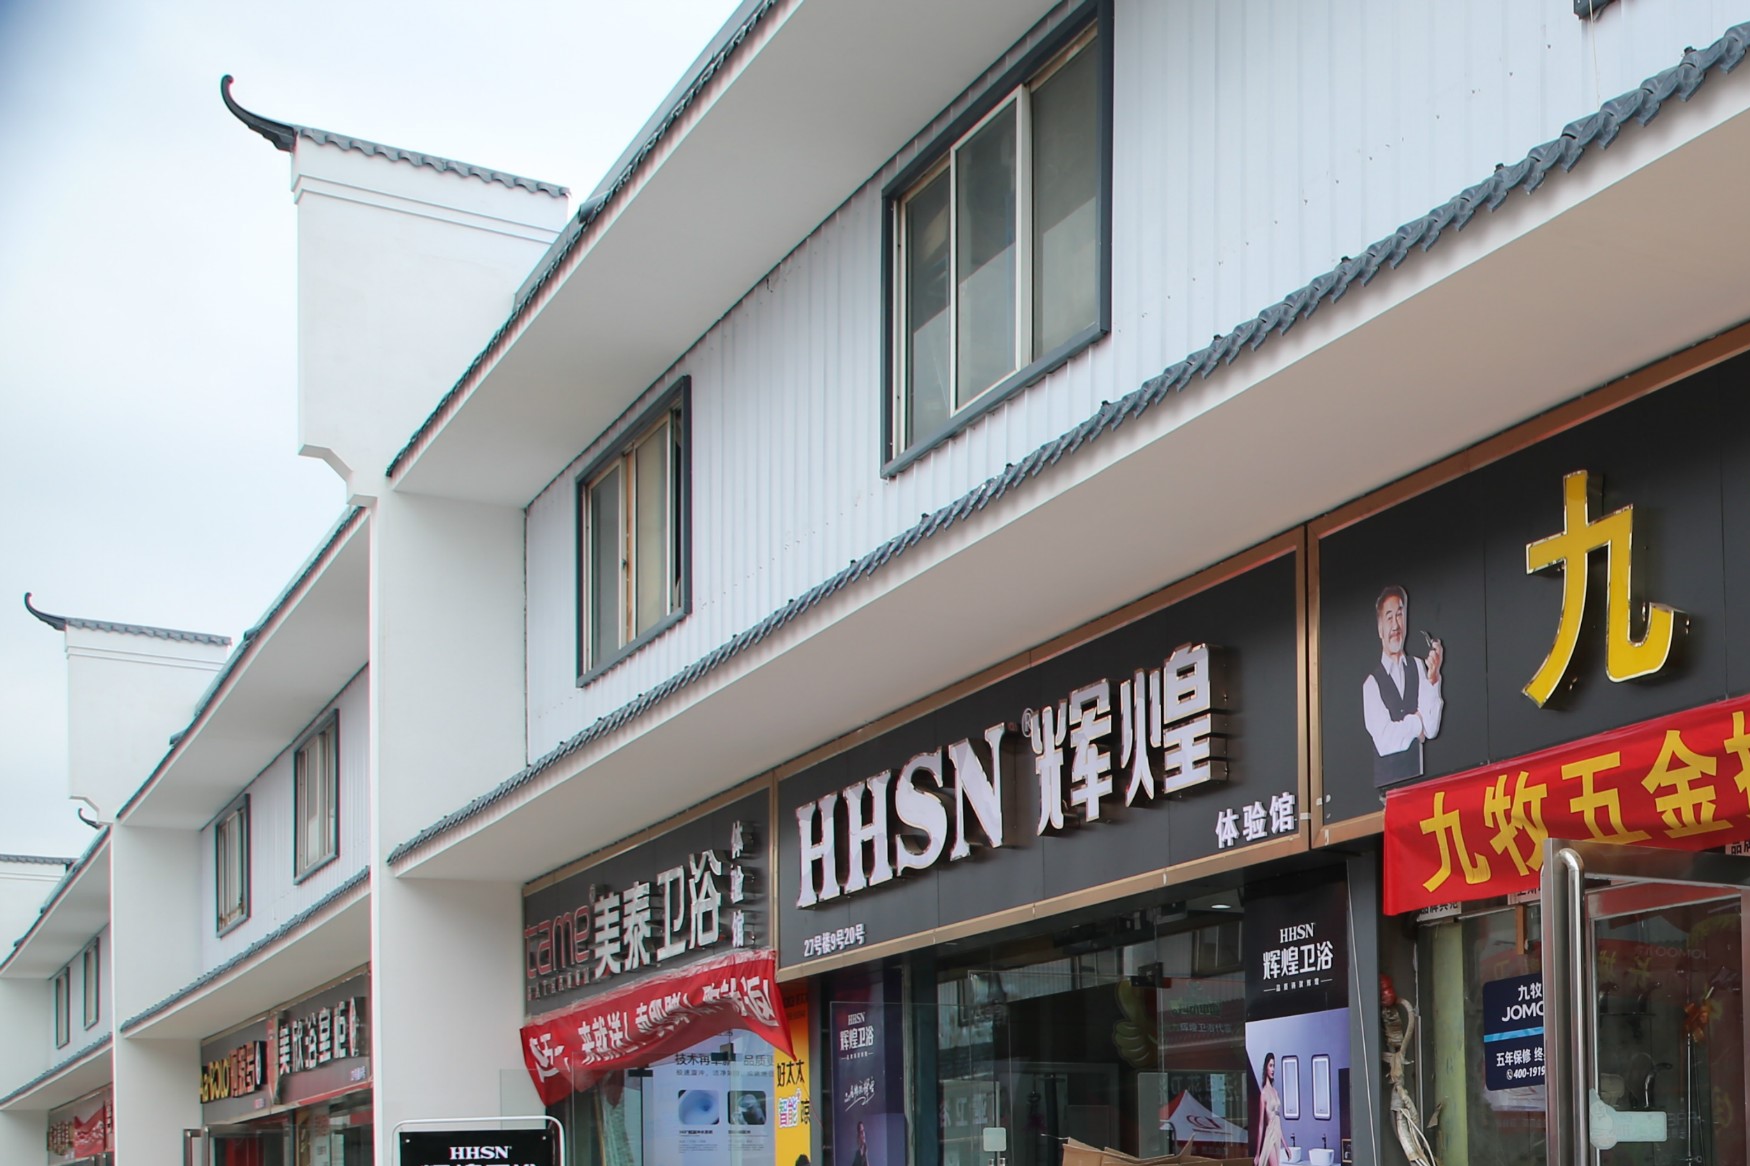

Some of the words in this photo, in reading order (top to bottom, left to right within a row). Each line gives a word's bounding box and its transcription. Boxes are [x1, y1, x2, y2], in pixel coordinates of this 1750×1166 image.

[796, 722, 1005, 907] HHSN
[1030, 642, 1213, 837] 辉煌
[1216, 792, 1296, 848] 体验馆
[594, 848, 722, 979] 美泰卫浴
[1279, 922, 1315, 944] HHSN
[1262, 940, 1334, 981] 辉煌卫浴
[839, 1025, 875, 1051] 辉煌卫浴
[776, 1058, 805, 1087] 好太太
[1495, 1049, 1531, 1067] 五年保修
[449, 1145, 510, 1160] HHSN
